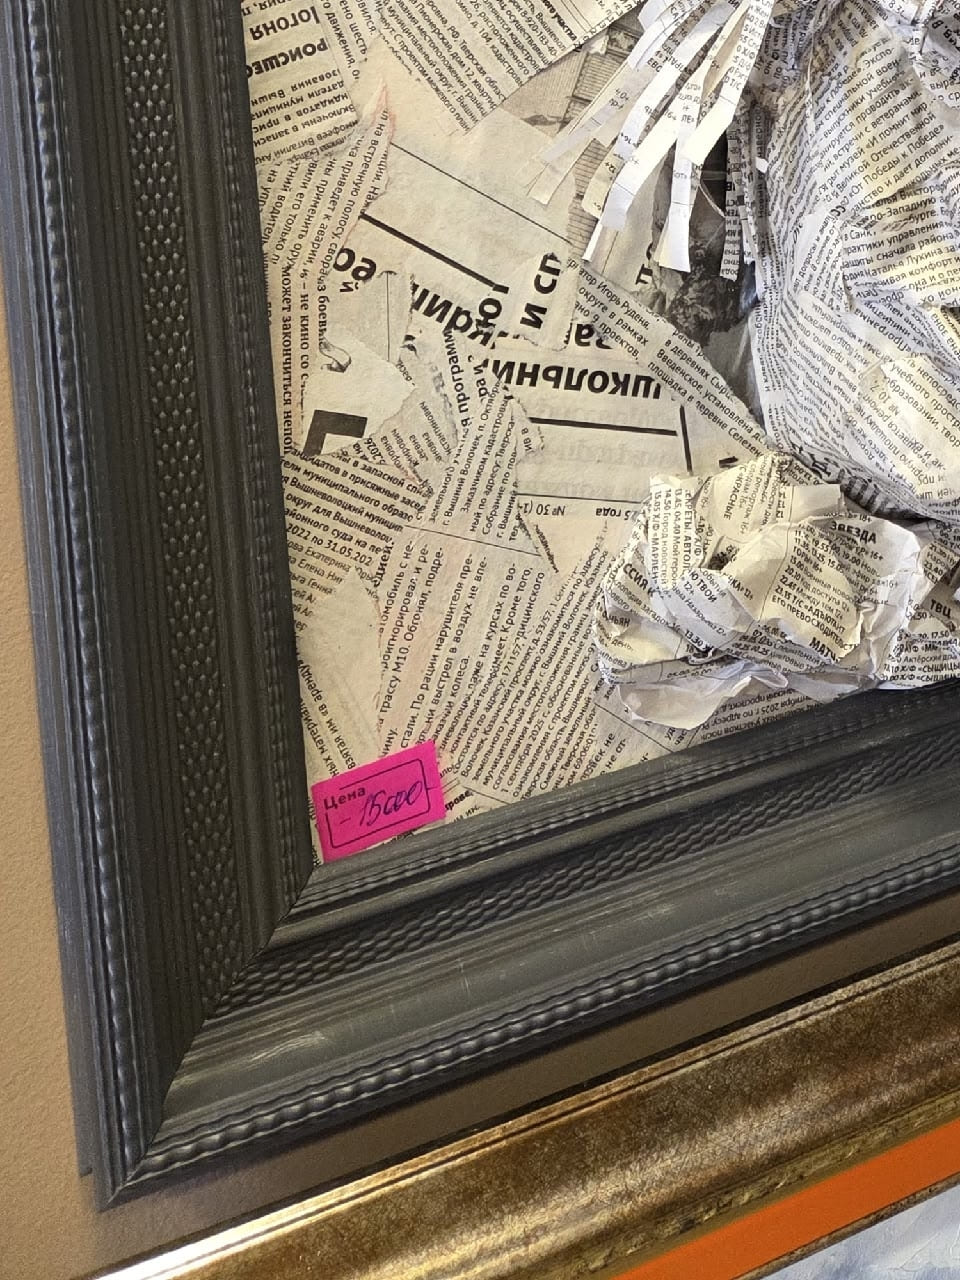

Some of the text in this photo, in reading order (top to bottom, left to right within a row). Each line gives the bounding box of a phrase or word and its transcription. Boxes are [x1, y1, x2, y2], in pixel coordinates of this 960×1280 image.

[300, 315, 309, 350] кино
[282, 316, 292, 406] закончиться
[536, 504, 622, 517] года 30
[828, 518, 876, 544] ЗВЕЗДА
[410, 693, 425, 710] По
[420, 654, 439, 691] рации
[434, 582, 464, 651] нарушителя
[431, 657, 454, 705] выстрел
[452, 603, 472, 644] воздух
[323, 787, 367, 810] Цена
